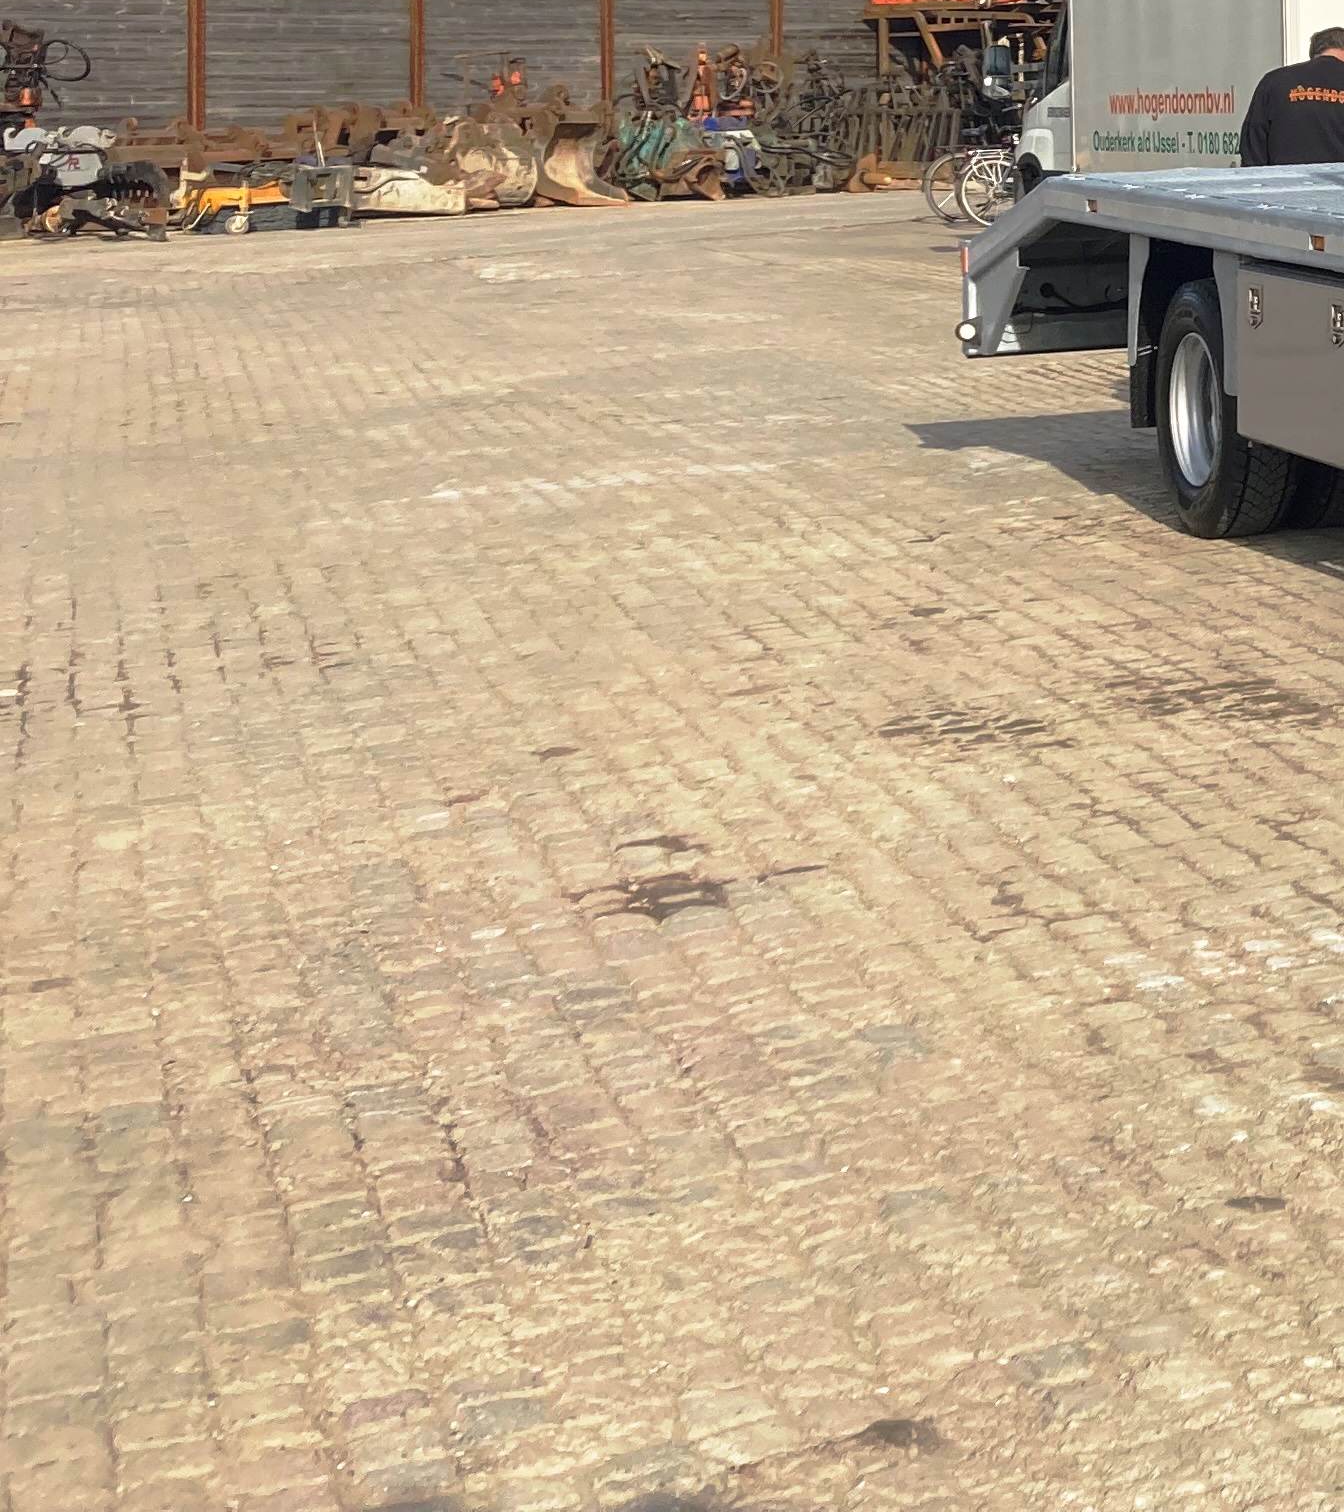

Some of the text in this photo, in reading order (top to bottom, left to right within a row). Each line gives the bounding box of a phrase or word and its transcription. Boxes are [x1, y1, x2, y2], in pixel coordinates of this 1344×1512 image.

[1109, 85, 1235, 121] www.hogendoornbv.nl
[1093, 130, 1135, 152] Ouderkerk
[1153, 131, 1179, 154] IJssel
[1187, 131, 1196, 154] T.
[1197, 131, 1220, 155] 0180
[1222, 131, 1240, 155] 682
